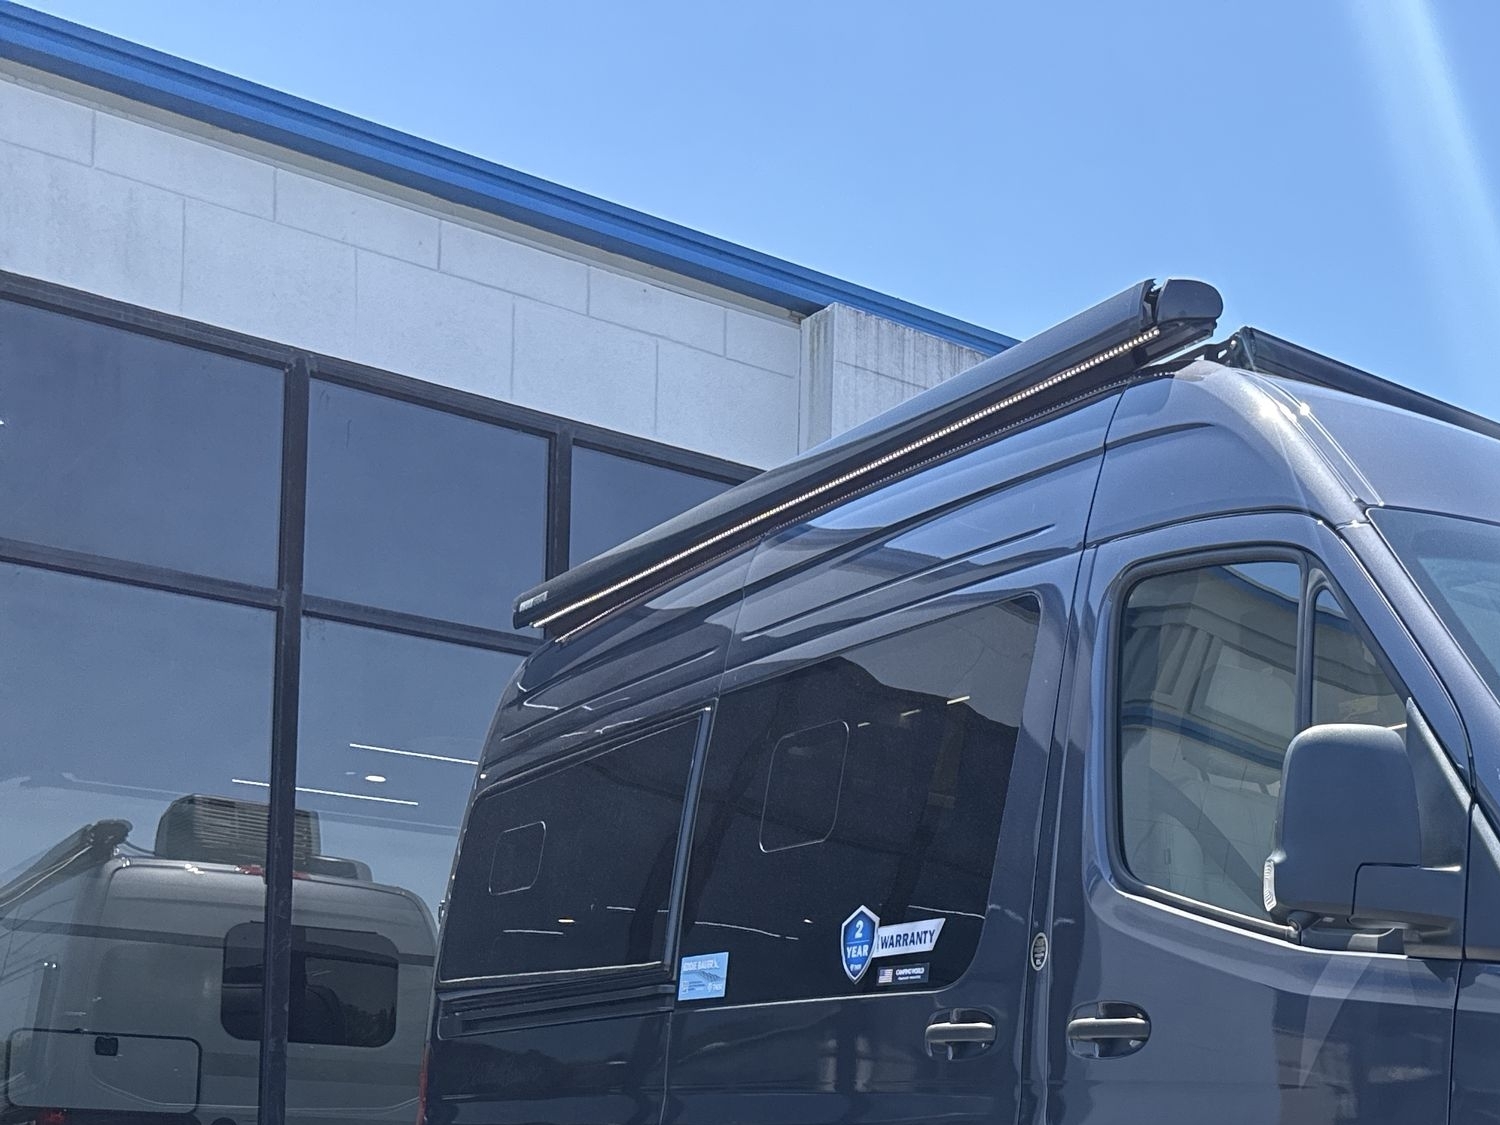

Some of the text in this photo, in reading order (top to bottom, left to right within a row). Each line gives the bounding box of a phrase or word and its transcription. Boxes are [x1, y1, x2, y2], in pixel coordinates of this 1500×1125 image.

[854, 920, 864, 939] 2
[881, 929, 935, 950] WARRANTY
[846, 944, 869, 959] YEAR
